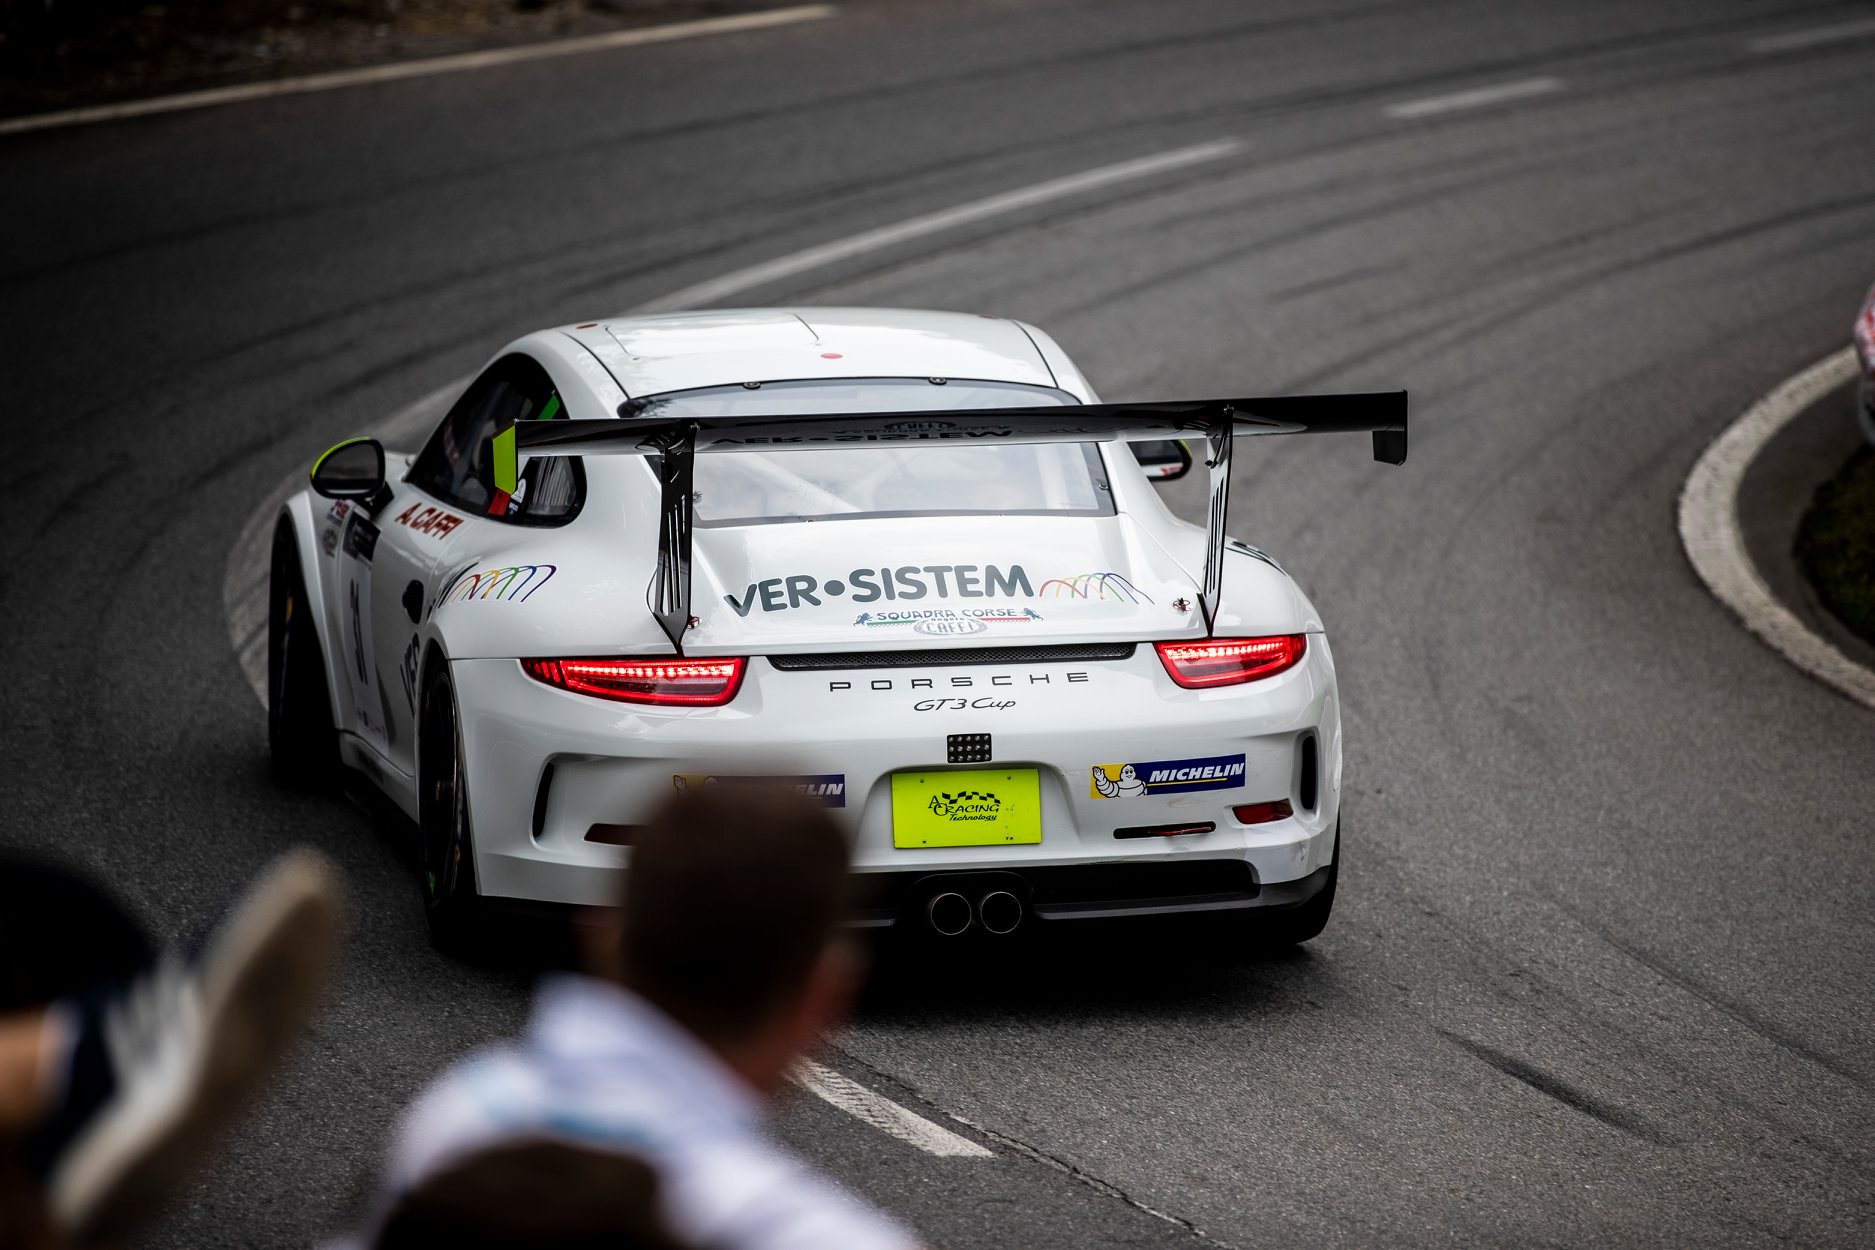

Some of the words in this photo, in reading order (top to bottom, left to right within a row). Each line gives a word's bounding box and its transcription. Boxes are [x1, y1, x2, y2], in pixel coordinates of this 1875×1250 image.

[876, 609, 956, 621] SQUADRA
[961, 608, 1018, 618] CORSE
[926, 619, 974, 633] CAFFI
[829, 671, 1090, 692] PORSCHE
[913, 698, 968, 712] GT3
[970, 696, 1016, 711] Cup
[1148, 761, 1246, 783] MICHELIN
[946, 803, 1000, 814] RACING
[949, 813, 998, 822] Technology
